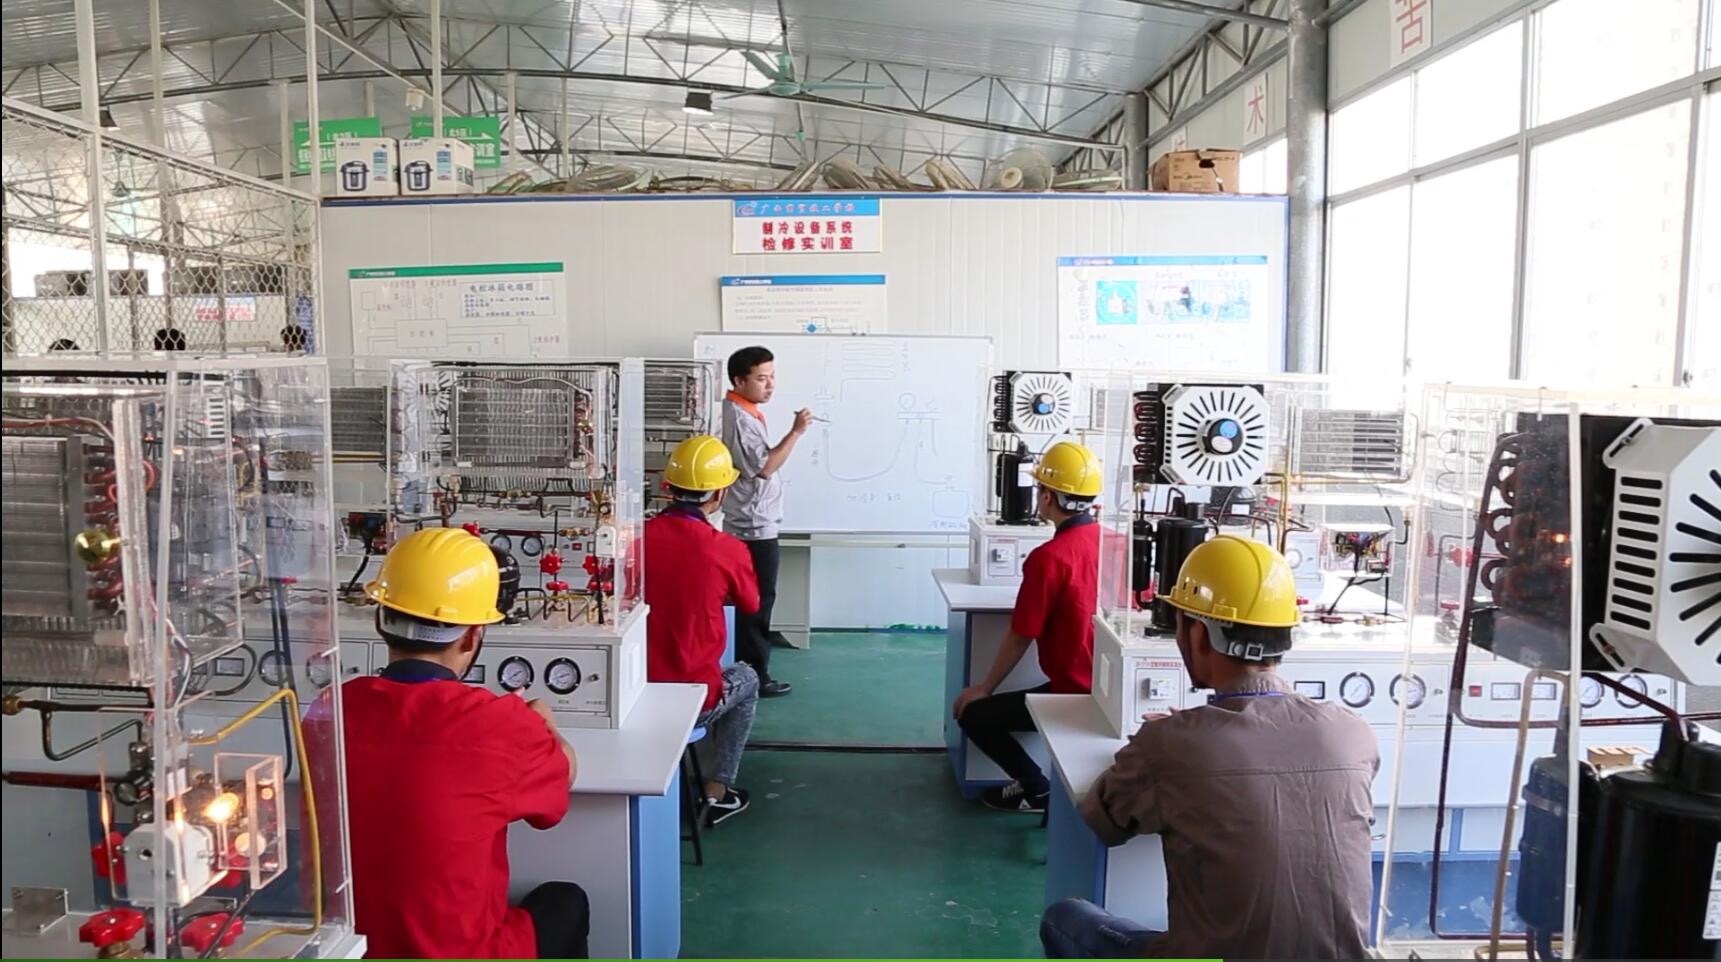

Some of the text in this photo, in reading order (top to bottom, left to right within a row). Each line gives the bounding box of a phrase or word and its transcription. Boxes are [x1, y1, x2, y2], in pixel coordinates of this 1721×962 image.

[762, 221, 853, 235] 制冷设备系统
[762, 237, 853, 250] 检修实训室
